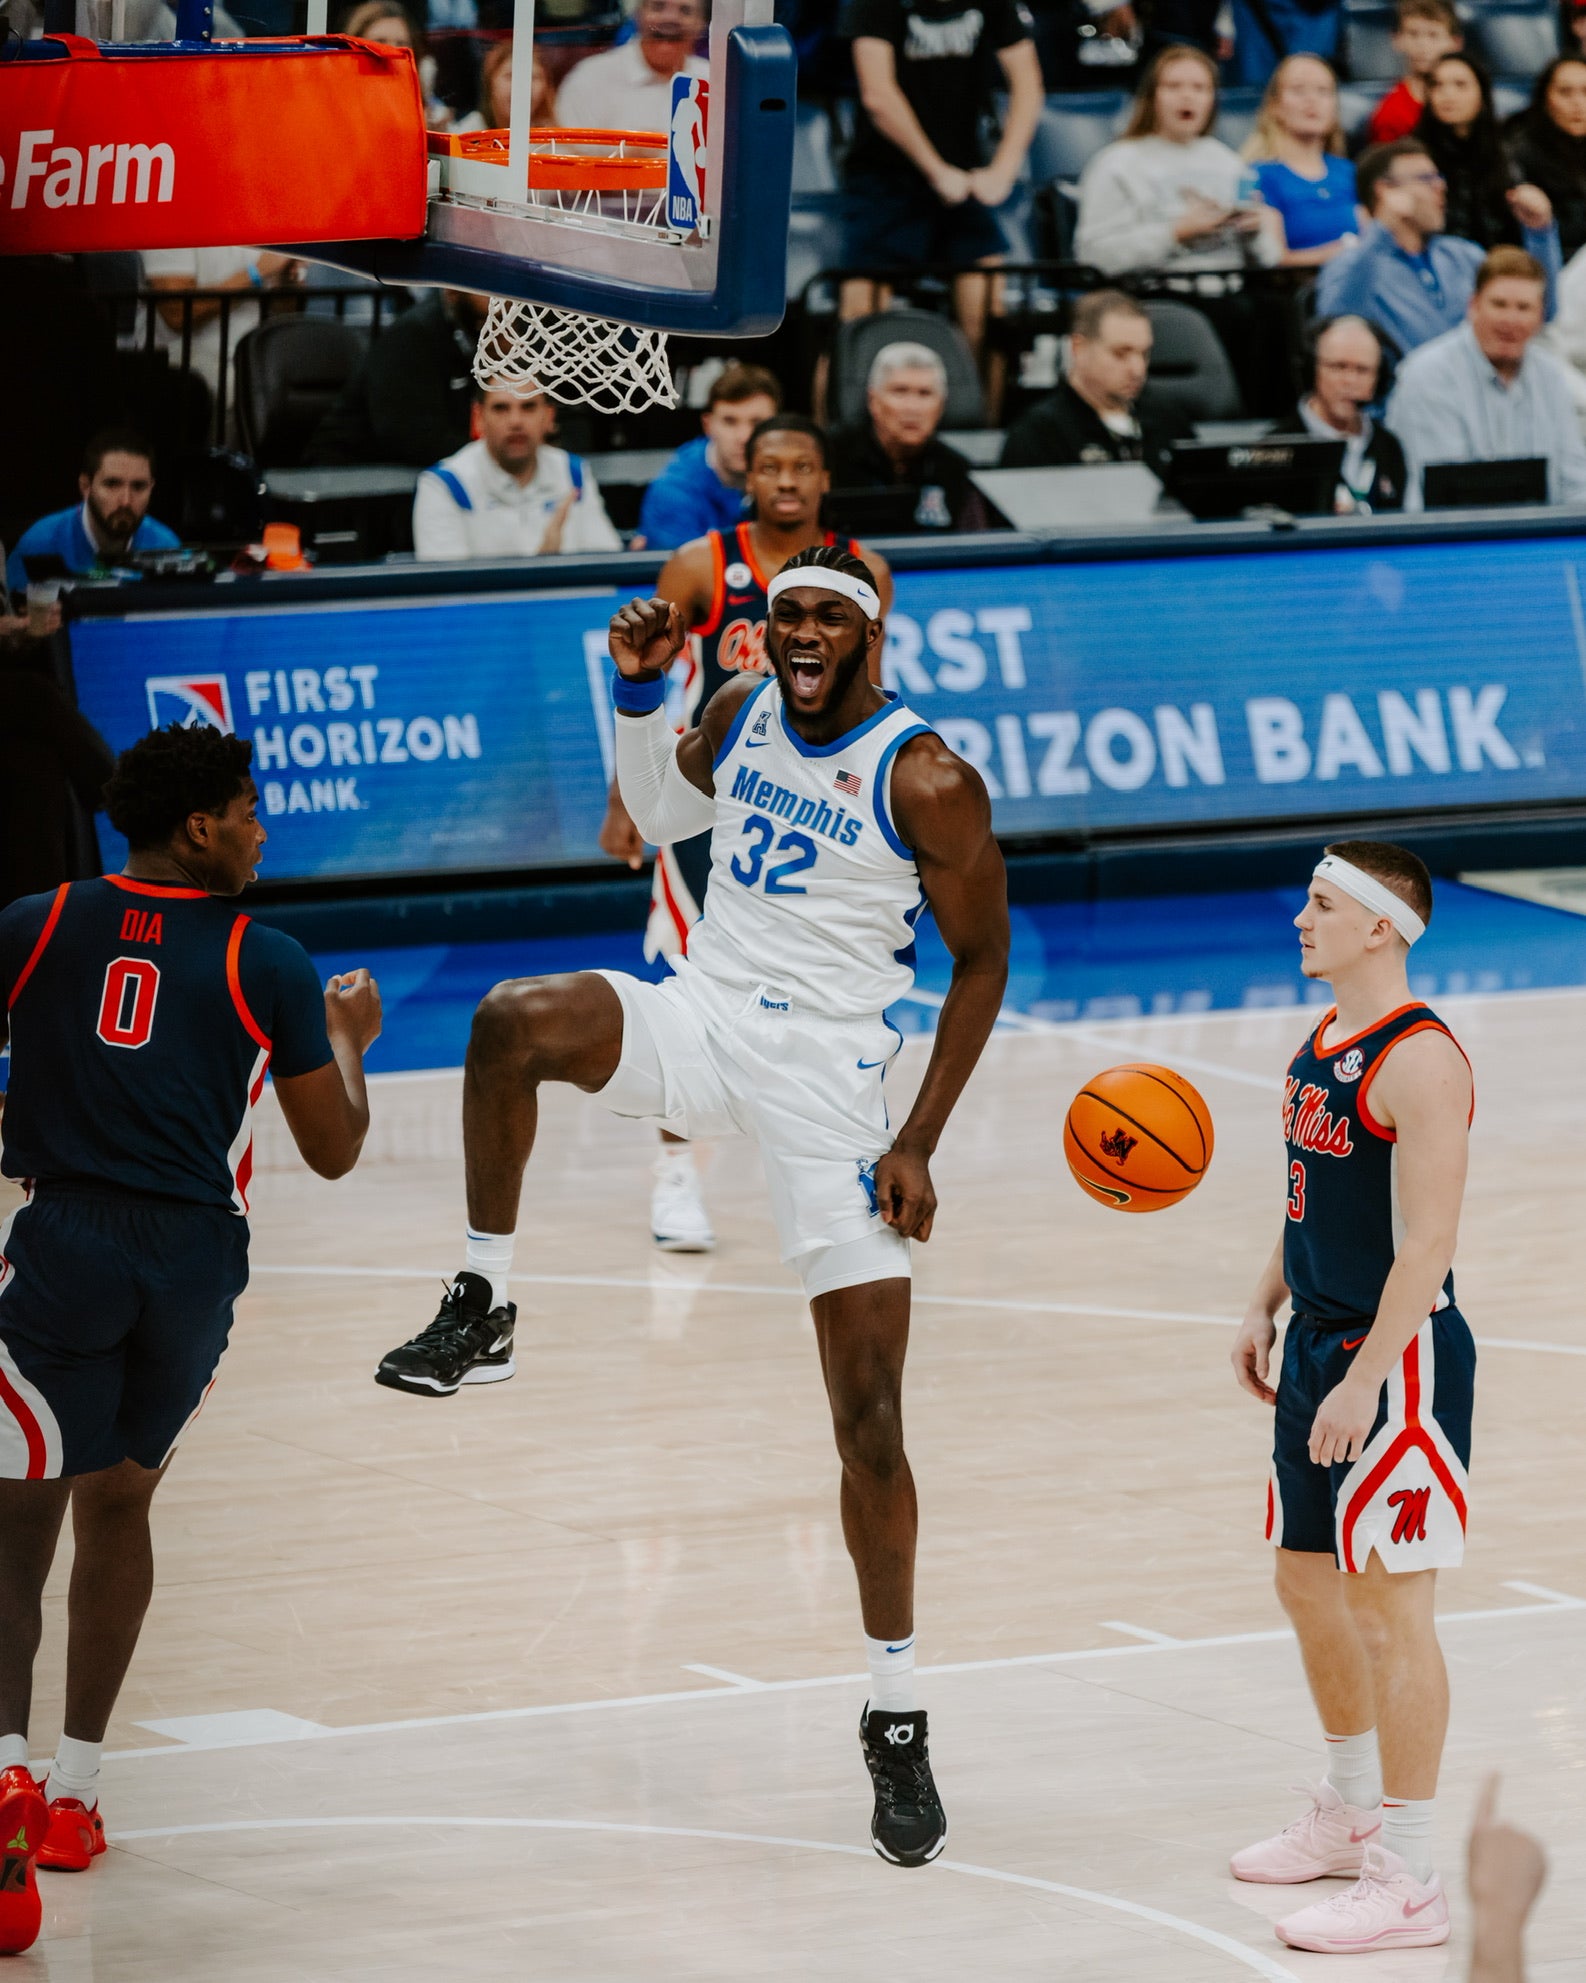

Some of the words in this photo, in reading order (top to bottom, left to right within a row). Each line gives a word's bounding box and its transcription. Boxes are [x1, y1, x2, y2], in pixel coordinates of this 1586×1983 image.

[10, 128, 176, 210] Farm
[672, 195, 693, 222] NBA
[880, 606, 1033, 695] RST
[245, 664, 379, 716] FIRST
[254, 712, 483, 771] HORIZON
[930, 702, 1225, 800] RIZON
[729, 764, 864, 847] Memphis
[730, 813, 819, 896] 32
[119, 908, 164, 946] DIA
[96, 955, 161, 1050] 0
[1293, 1083, 1354, 1158] Miss
[1286, 1159, 1307, 1223] 3
